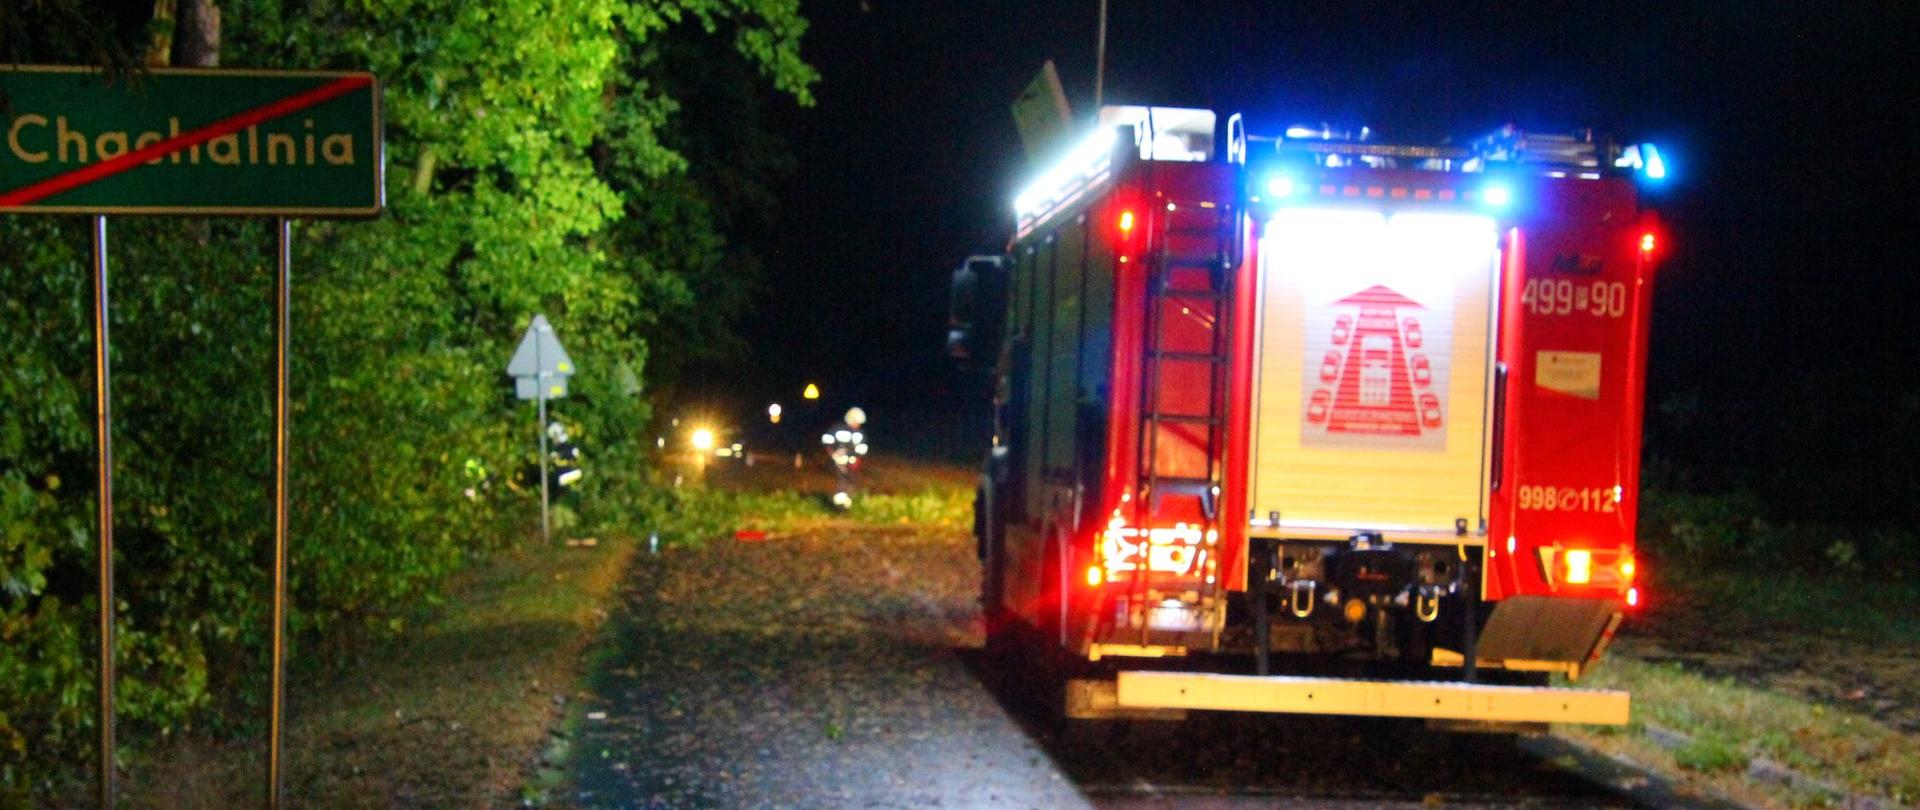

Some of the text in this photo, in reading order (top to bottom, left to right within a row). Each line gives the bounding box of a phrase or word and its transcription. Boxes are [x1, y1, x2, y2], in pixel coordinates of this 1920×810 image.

[7, 114, 355, 165] Chachalnia
[1519, 485, 1616, 513] 998 112
